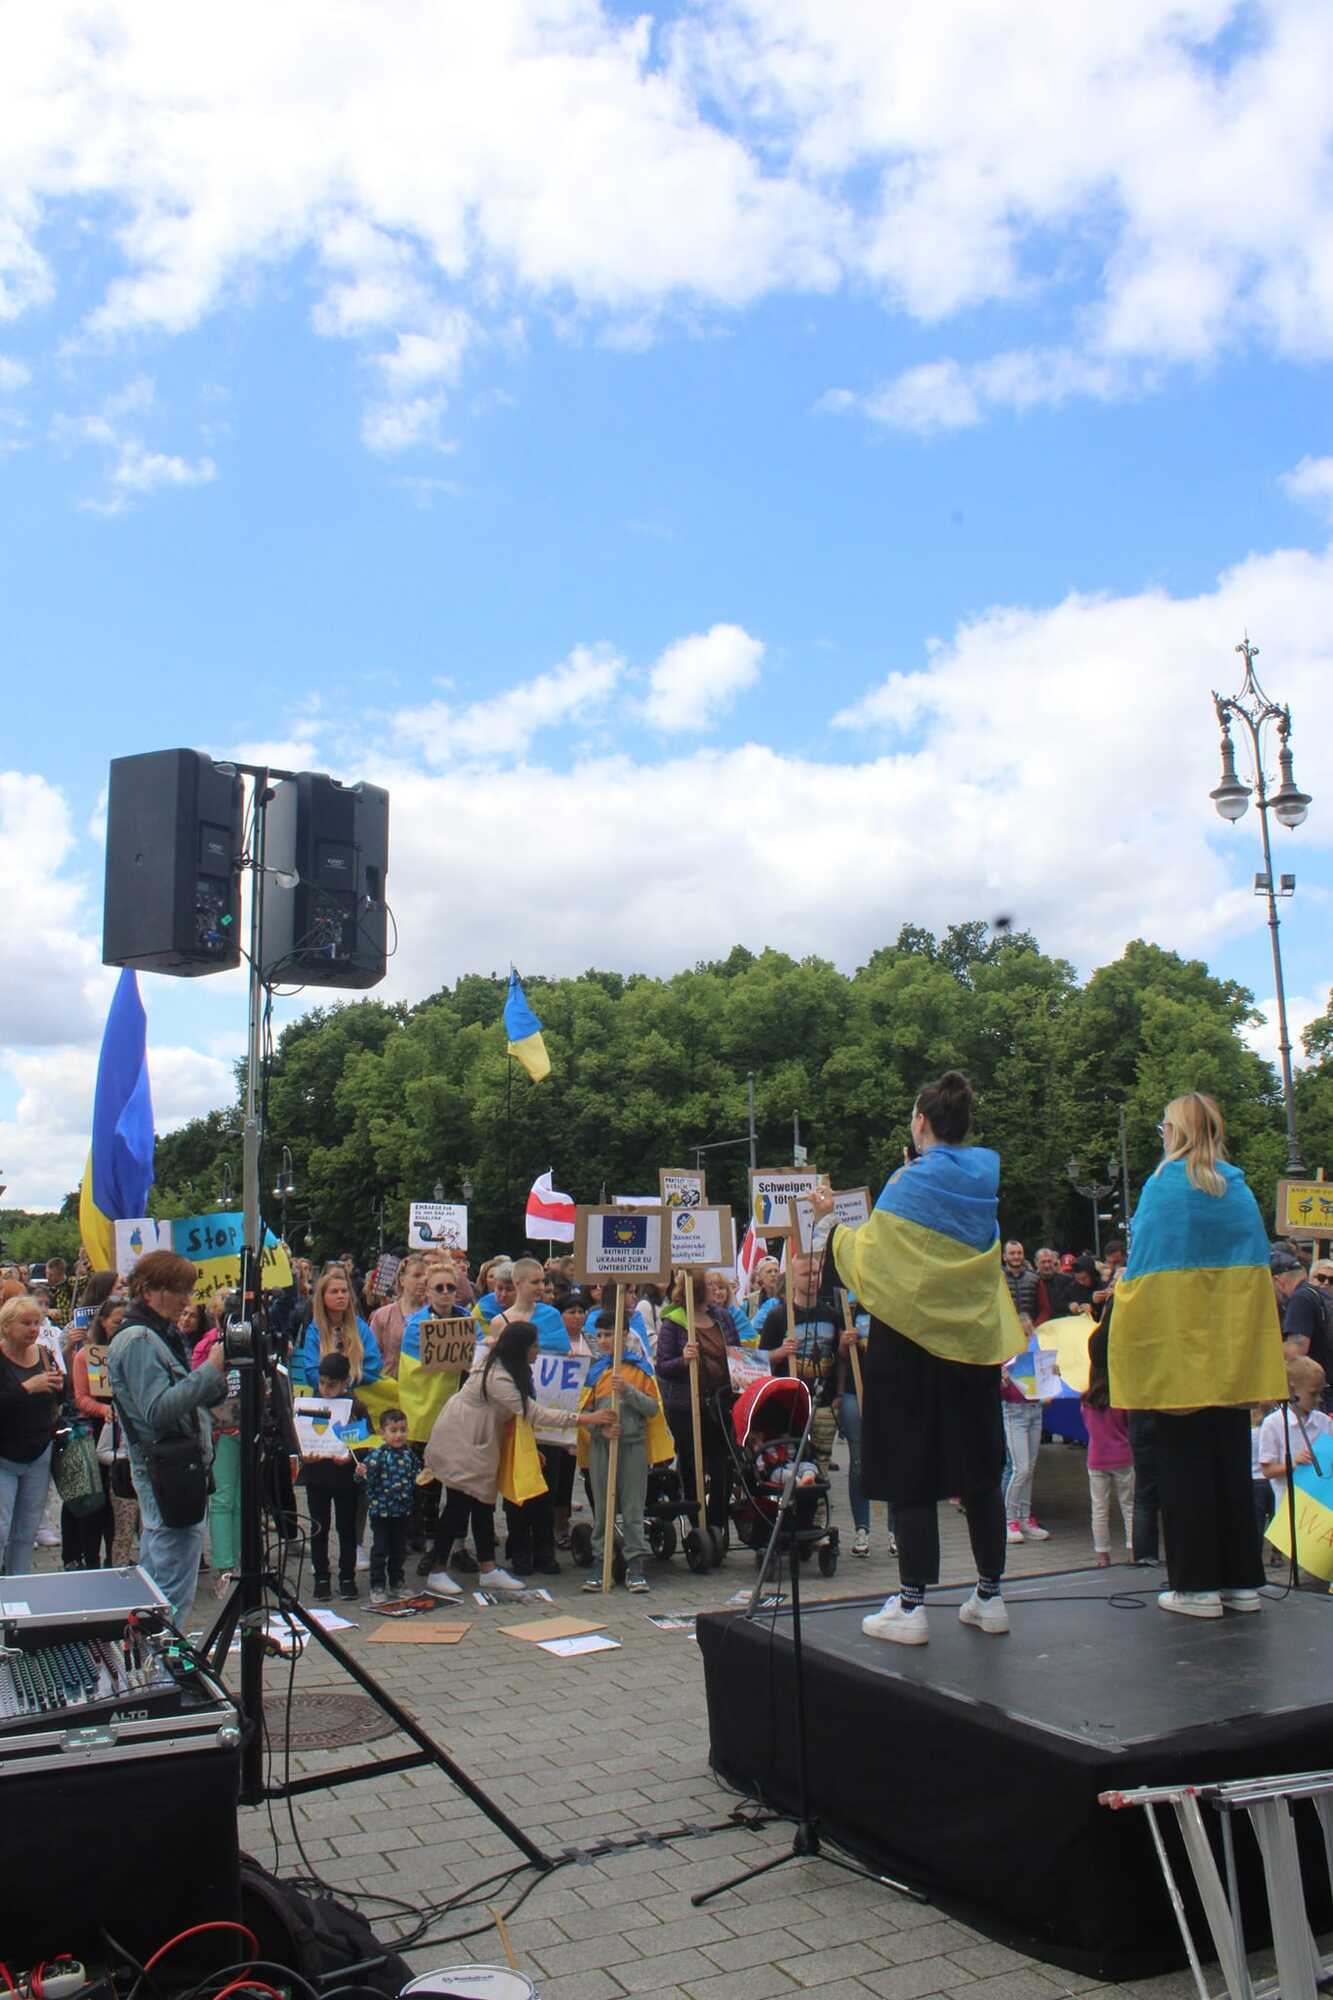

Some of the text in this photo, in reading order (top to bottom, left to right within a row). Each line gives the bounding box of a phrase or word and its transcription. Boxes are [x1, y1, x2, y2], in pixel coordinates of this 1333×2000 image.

[758, 1182, 812, 1193] Schweigen
[598, 1263, 649, 1272] UNTERSTÜTZEN
[425, 1320, 475, 1340] PUTIN
[540, 1358, 582, 1390] VE
[110, 1709, 149, 1722] ALTO
